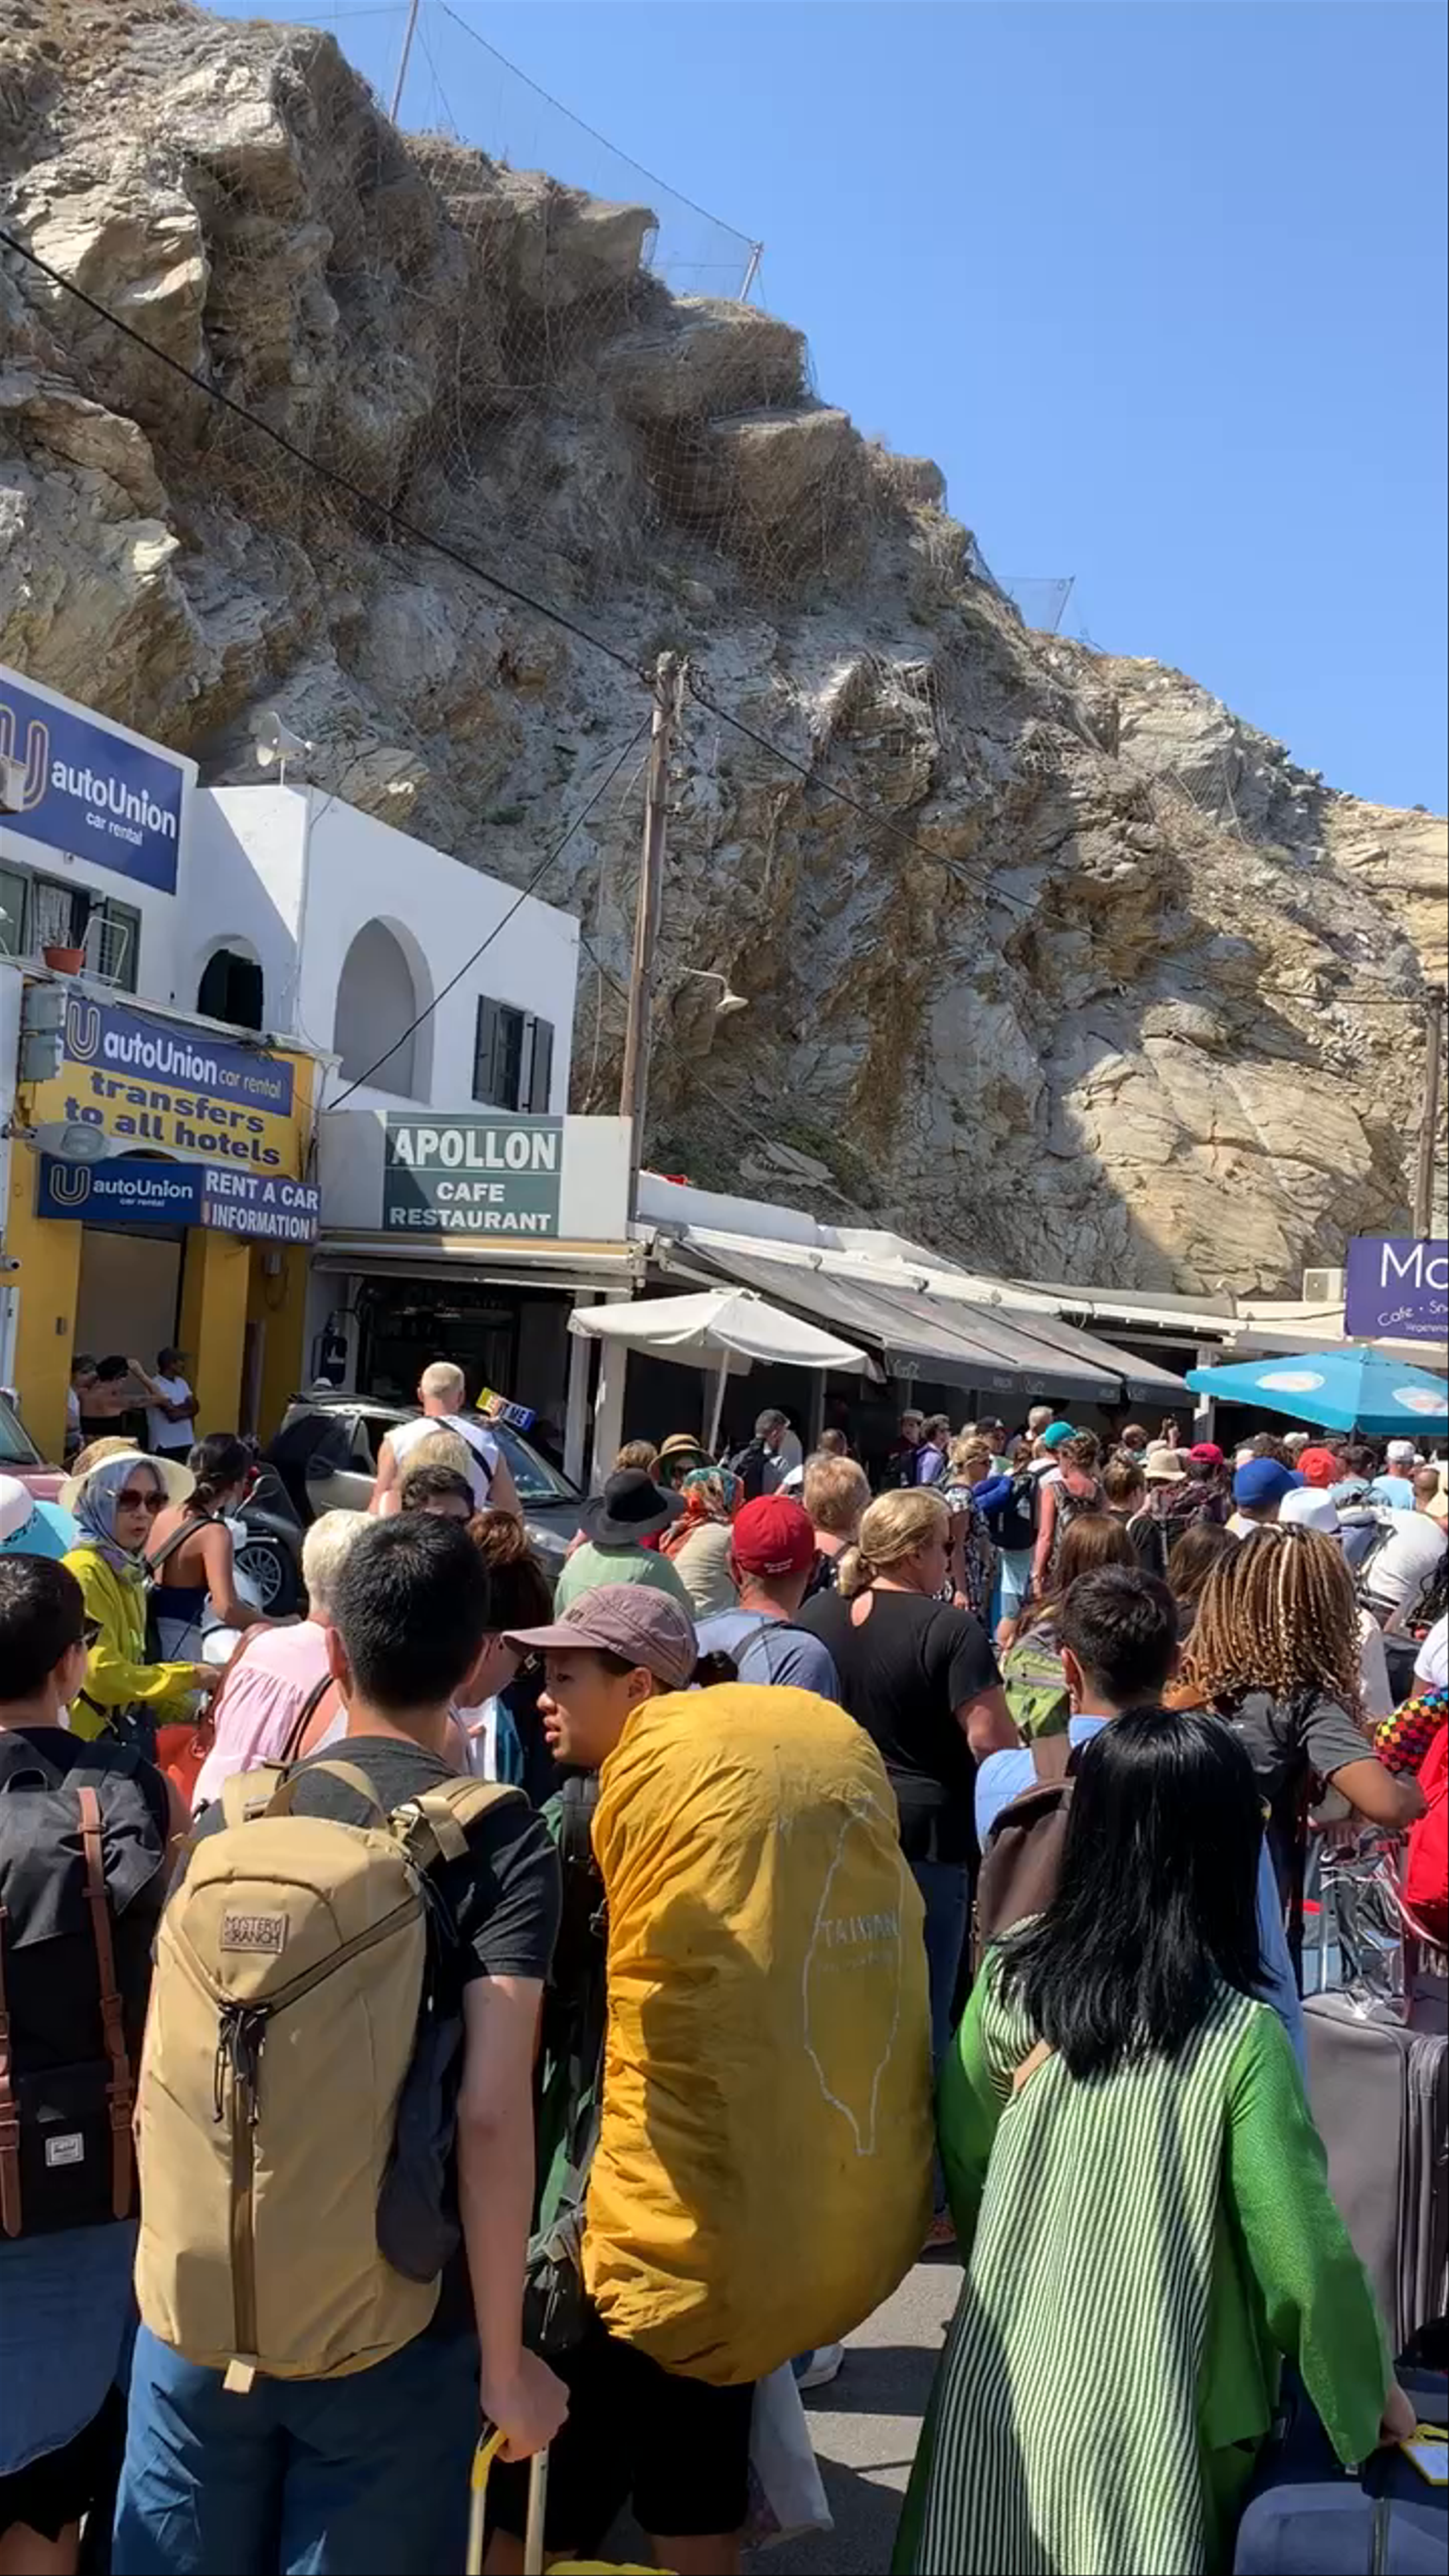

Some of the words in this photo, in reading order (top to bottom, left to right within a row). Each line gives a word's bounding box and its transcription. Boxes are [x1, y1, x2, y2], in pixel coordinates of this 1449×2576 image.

[51, 761, 177, 839] autoUnion
[85, 812, 107, 829] car
[109, 821, 143, 846] rental
[103, 1031, 217, 1086] autoUnion
[218, 1068, 241, 1088] car
[243, 1074, 281, 1099] rental
[91, 1071, 265, 1133] transfers
[65, 1096, 104, 1125] to
[115, 1113, 165, 1141] all
[175, 1121, 280, 1165] hotels
[391, 1128, 556, 1170] APOLLON
[92, 1179, 194, 1199] autoUnion
[206, 1170, 258, 1200] RENT
[262, 1182, 276, 1203] A
[281, 1186, 318, 1211] CAR
[436, 1181, 505, 1202] CAFE
[212, 1203, 310, 1240] INFORMATION
[390, 1207, 551, 1232] RESTAURANT
[225, 1916, 281, 1931] MYSTERY
